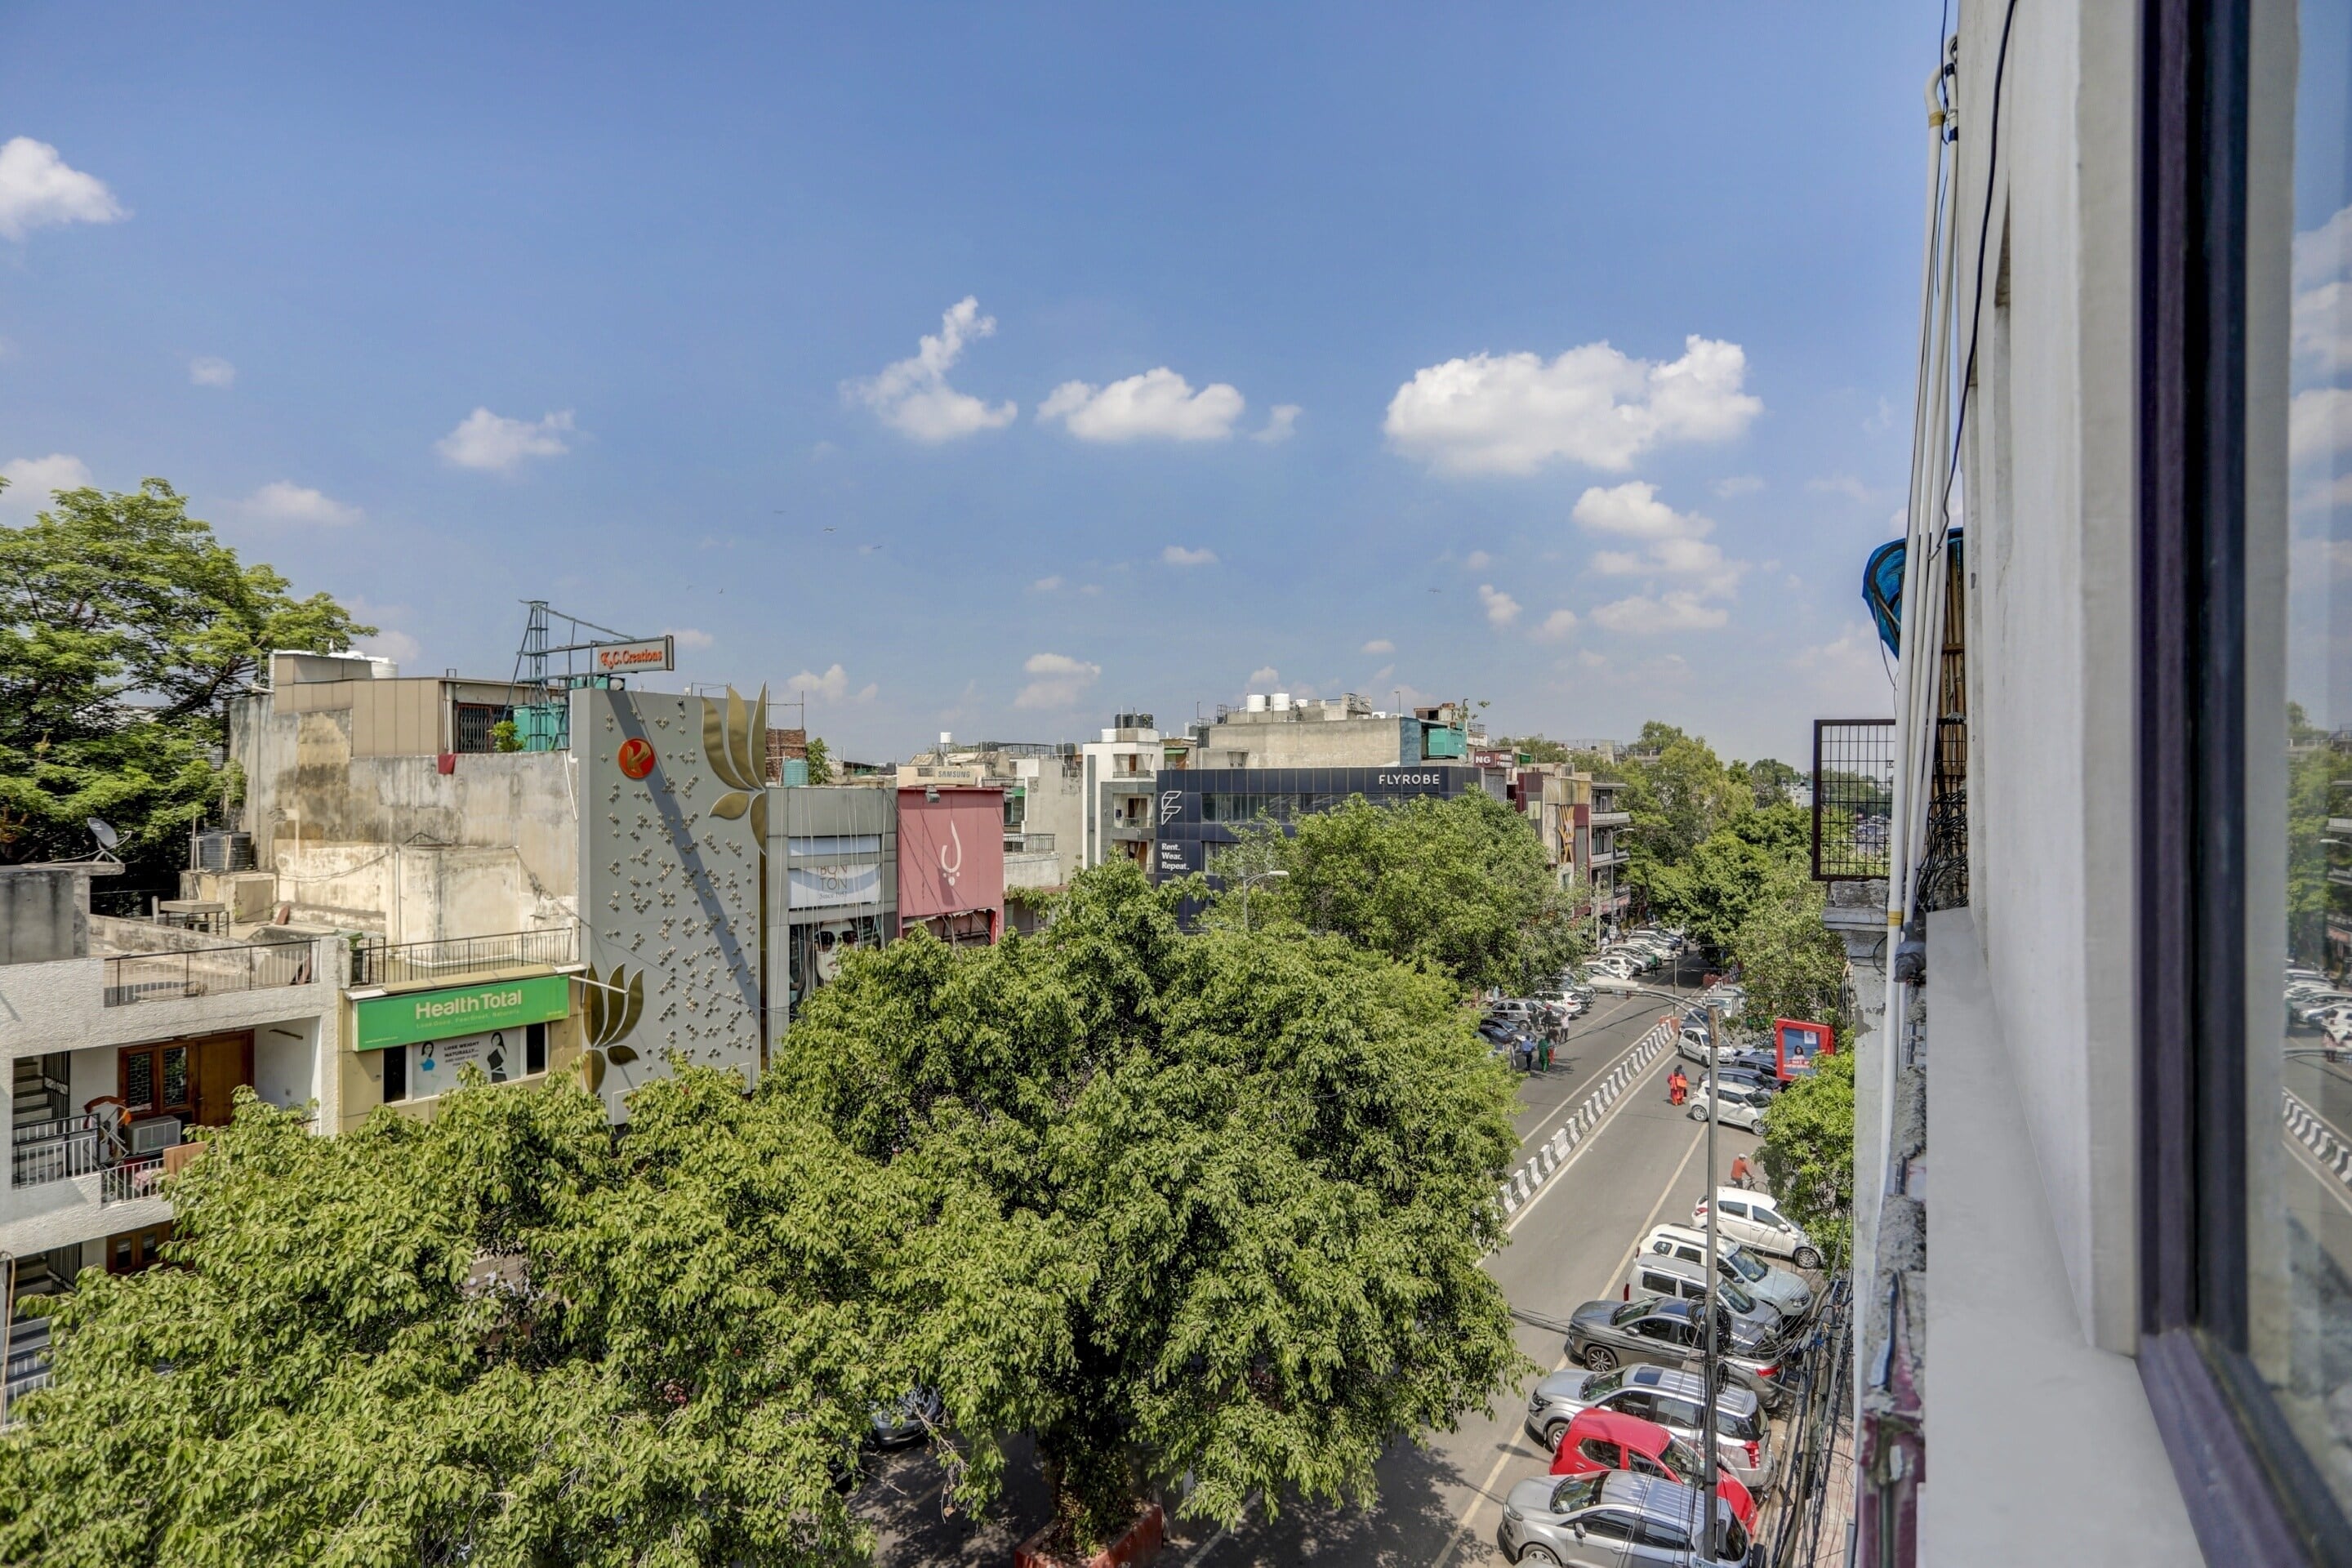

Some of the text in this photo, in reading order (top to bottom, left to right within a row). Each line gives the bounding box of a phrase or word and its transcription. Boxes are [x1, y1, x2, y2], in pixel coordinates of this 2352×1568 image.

[622, 649, 662, 664] Creations
[1379, 774, 1440, 785] FLYROBE
[1161, 842, 1180, 851] Rent.
[1161, 852, 1183, 861] Wear.
[1161, 861, 1190, 871] Repeat.
[819, 877, 848, 892] TON
[415, 989, 523, 1020] Health Total
[459, 1040, 480, 1049] WEIGHT
